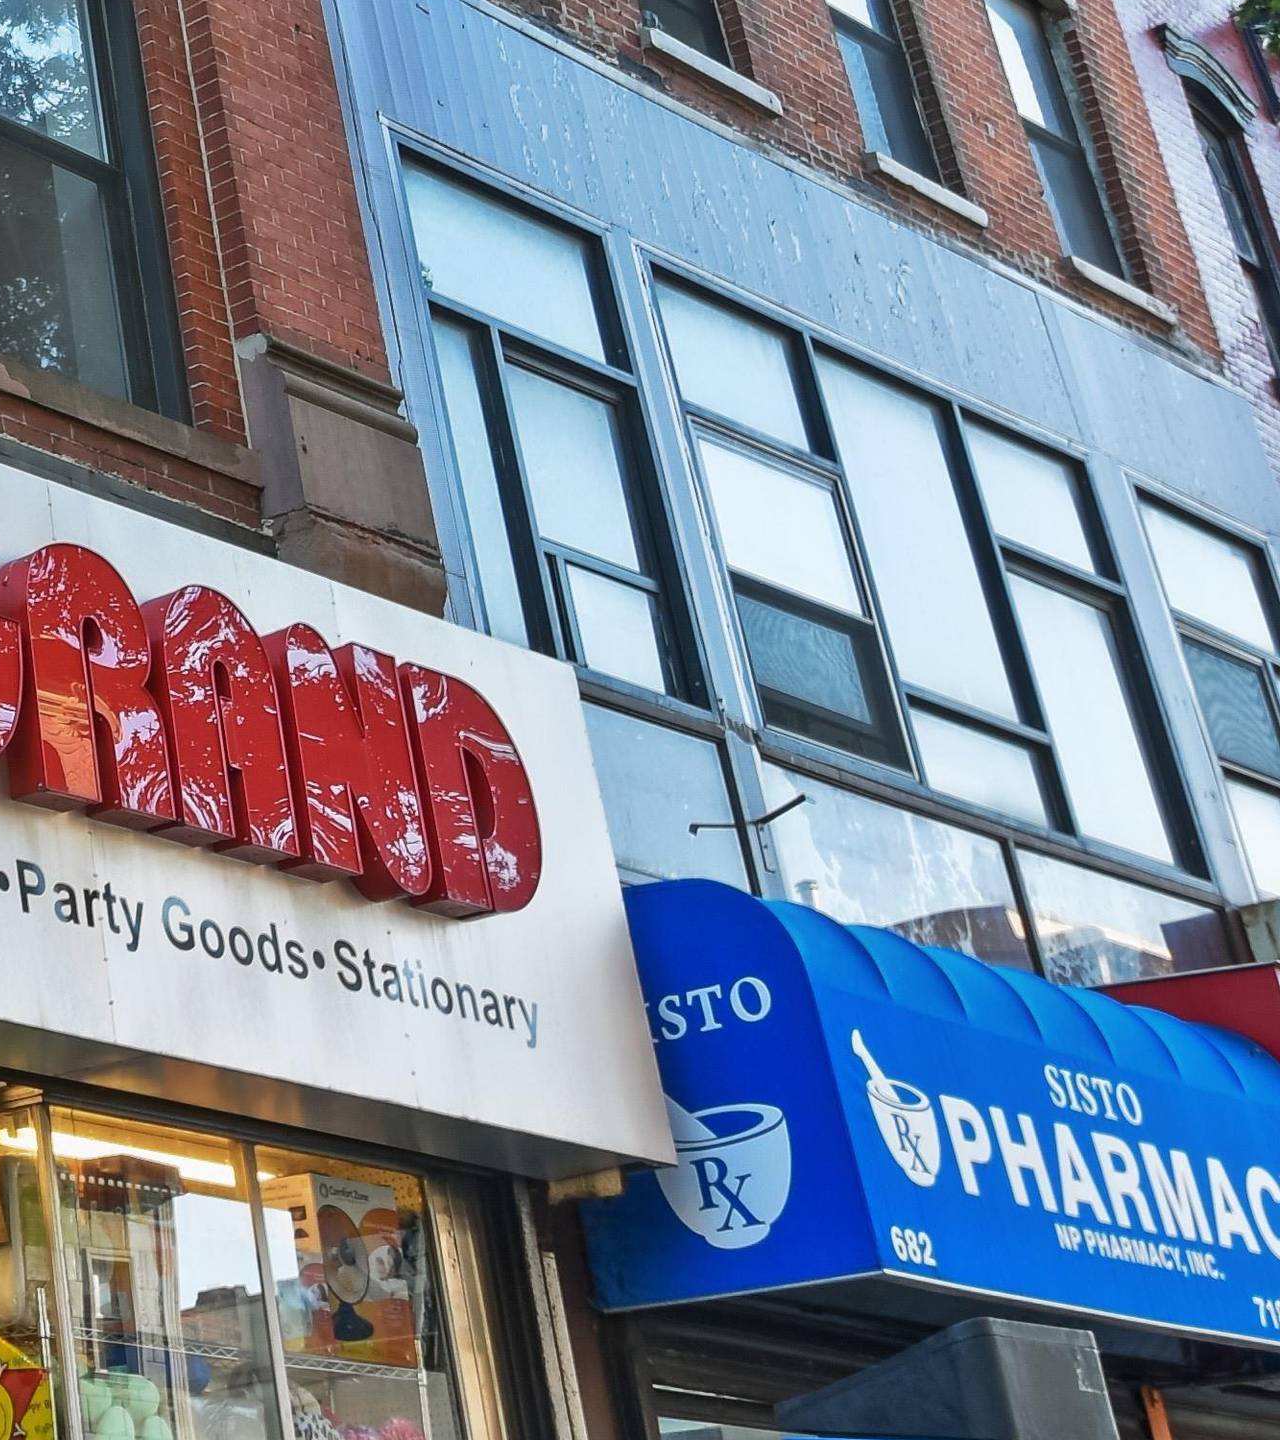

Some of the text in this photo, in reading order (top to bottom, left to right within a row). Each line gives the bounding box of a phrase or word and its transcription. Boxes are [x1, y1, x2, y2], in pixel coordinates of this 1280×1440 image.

[1043, 1064, 1143, 1126] SISTO
[890, 1226, 937, 1267] 682
[1054, 1223, 1082, 1252] NP
